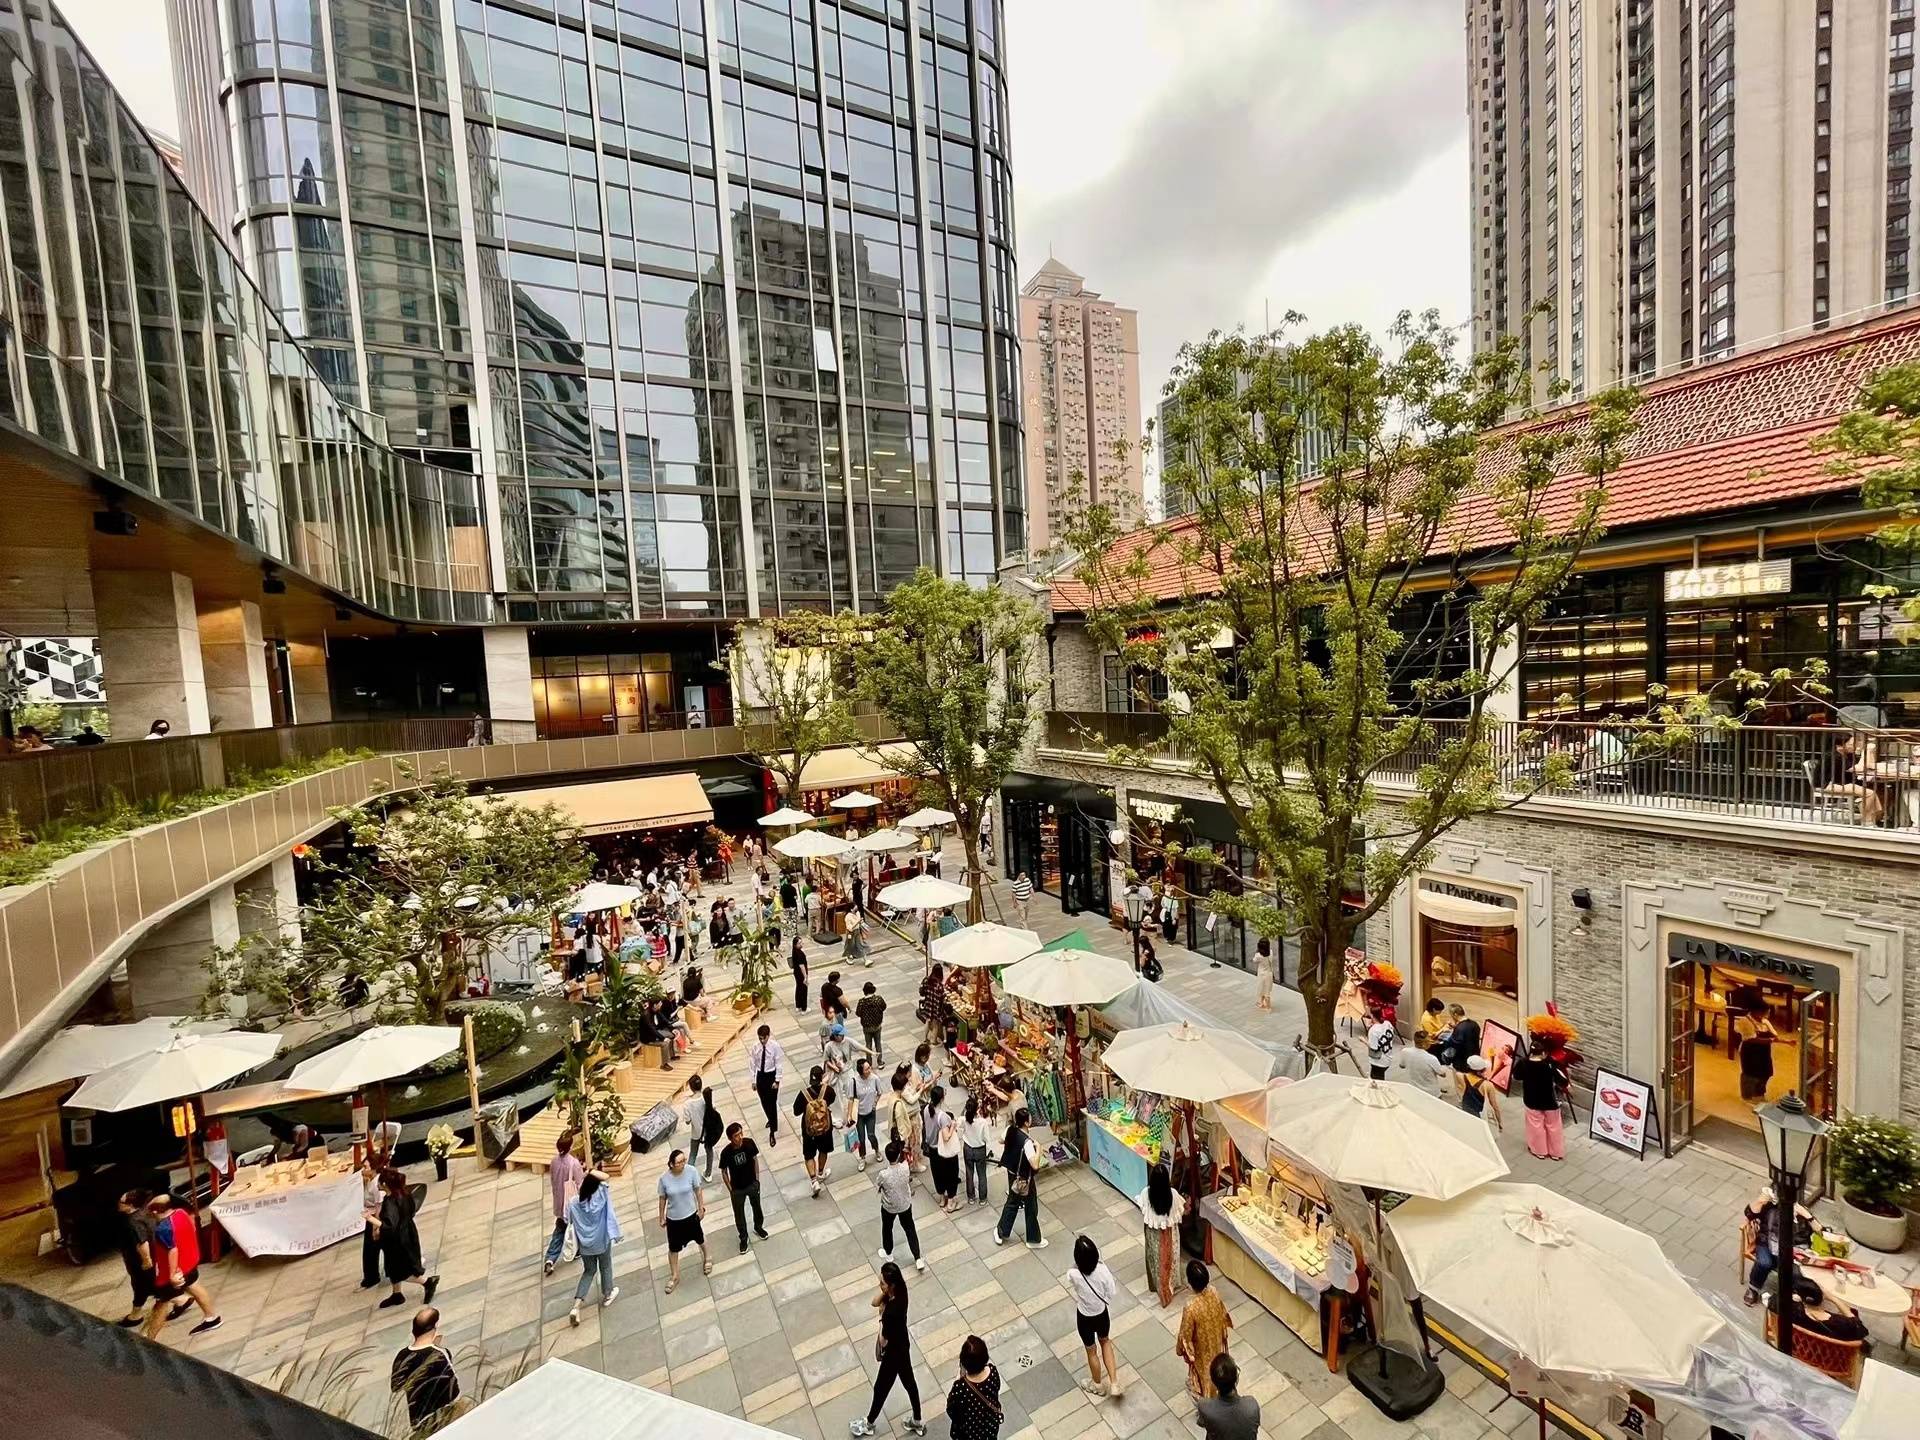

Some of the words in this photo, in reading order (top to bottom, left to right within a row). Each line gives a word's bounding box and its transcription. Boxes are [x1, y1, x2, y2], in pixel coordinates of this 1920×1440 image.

[1429, 882, 1442, 894] LA
[1686, 940, 1706, 956] LA
[288, 1220, 362, 1250] Fragrance
